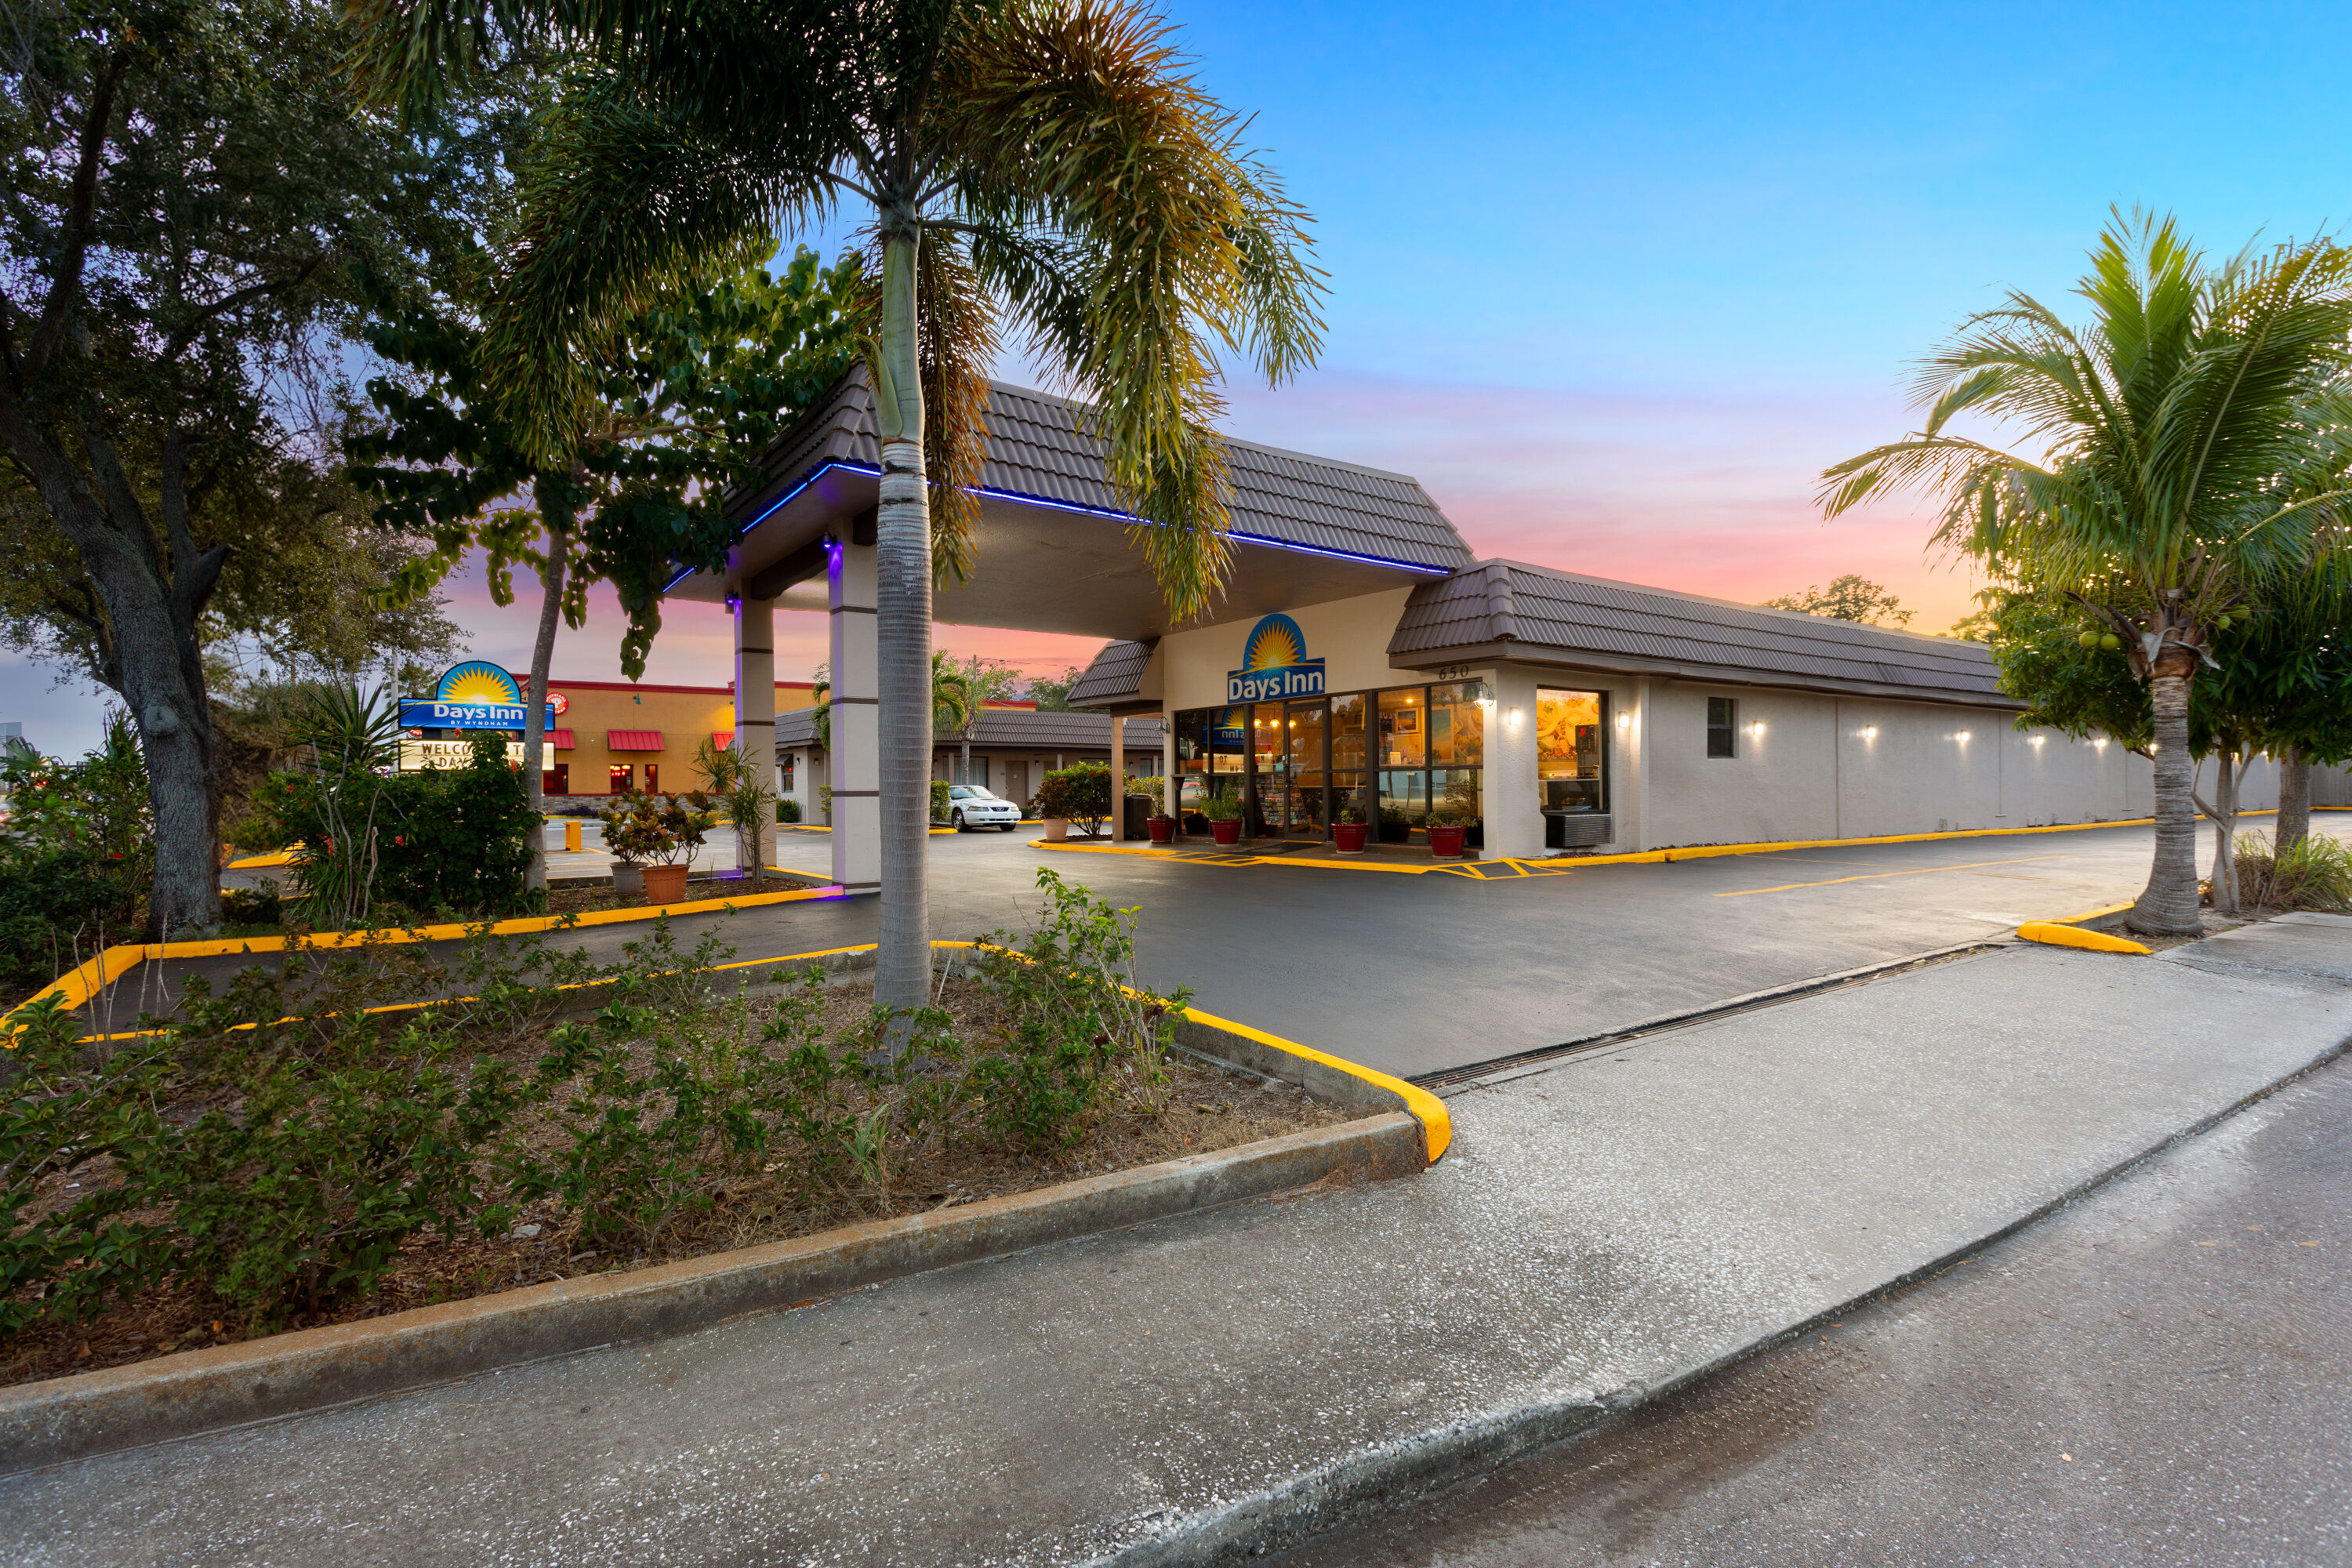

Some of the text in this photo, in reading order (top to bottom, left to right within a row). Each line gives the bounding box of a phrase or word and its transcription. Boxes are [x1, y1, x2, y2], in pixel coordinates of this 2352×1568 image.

[1439, 665, 1468, 680] 650
[1229, 671, 1323, 701] Days Inn
[434, 704, 523, 720] Days Inn
[421, 743, 470, 755] WELCO
